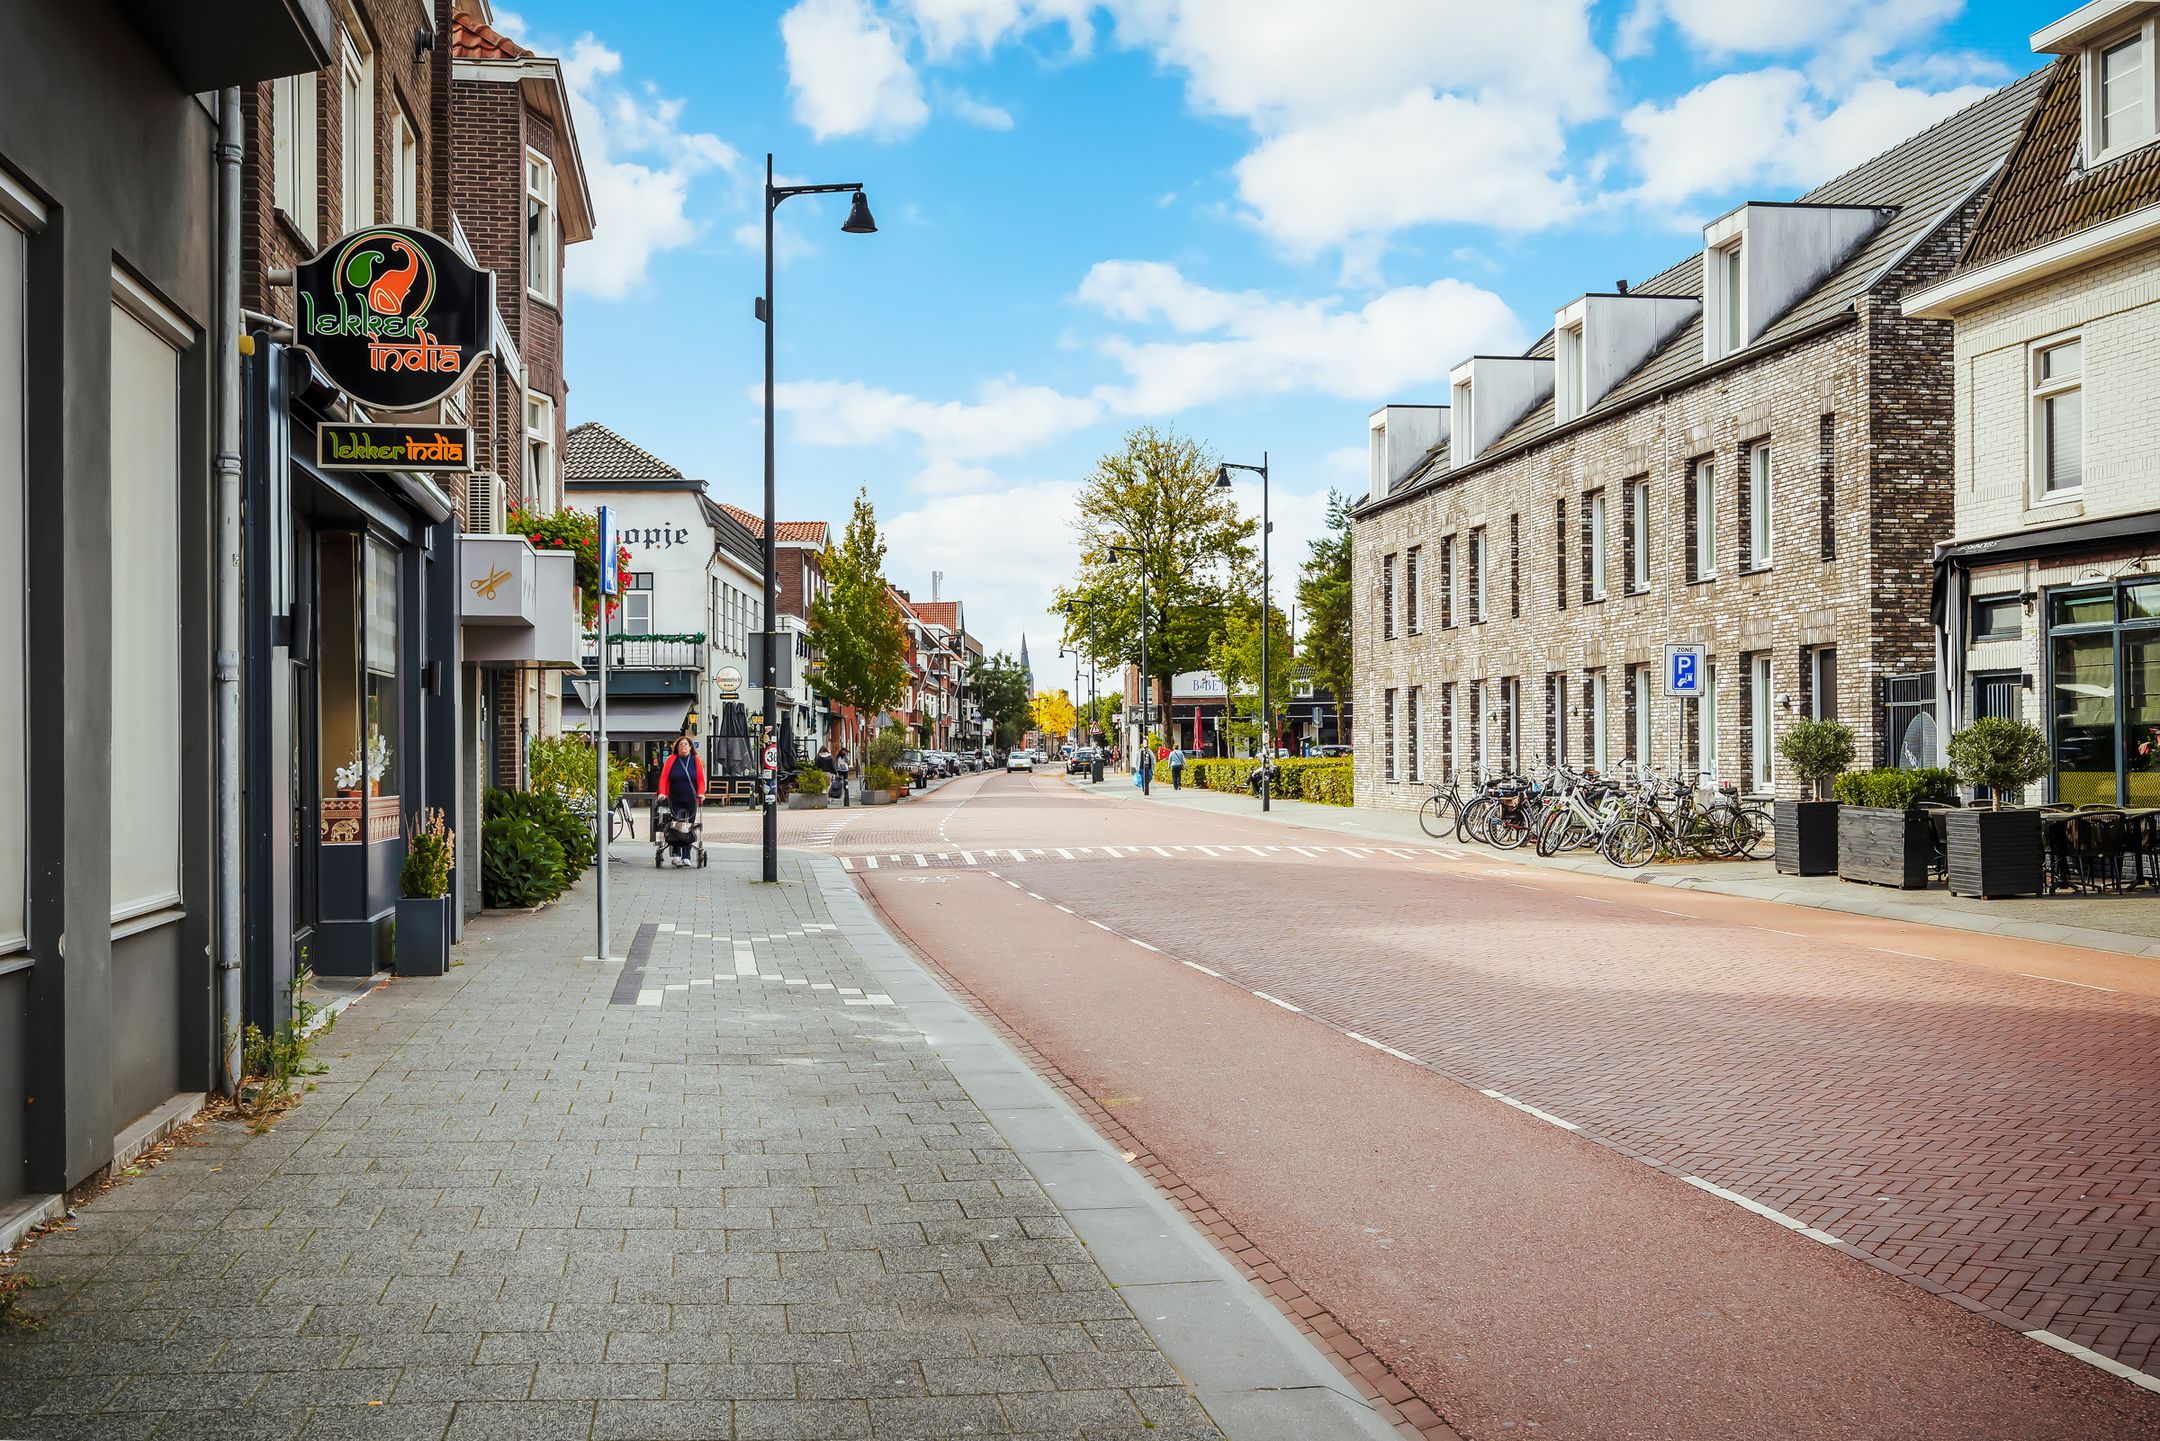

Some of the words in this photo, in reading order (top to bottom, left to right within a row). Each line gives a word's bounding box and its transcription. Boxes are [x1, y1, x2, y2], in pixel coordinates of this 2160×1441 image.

[300, 291, 428, 338] lekker
[368, 327, 462, 373] india
[329, 432, 406, 460] lekker
[405, 432, 464, 461] india
[1678, 656, 1691, 674] P
